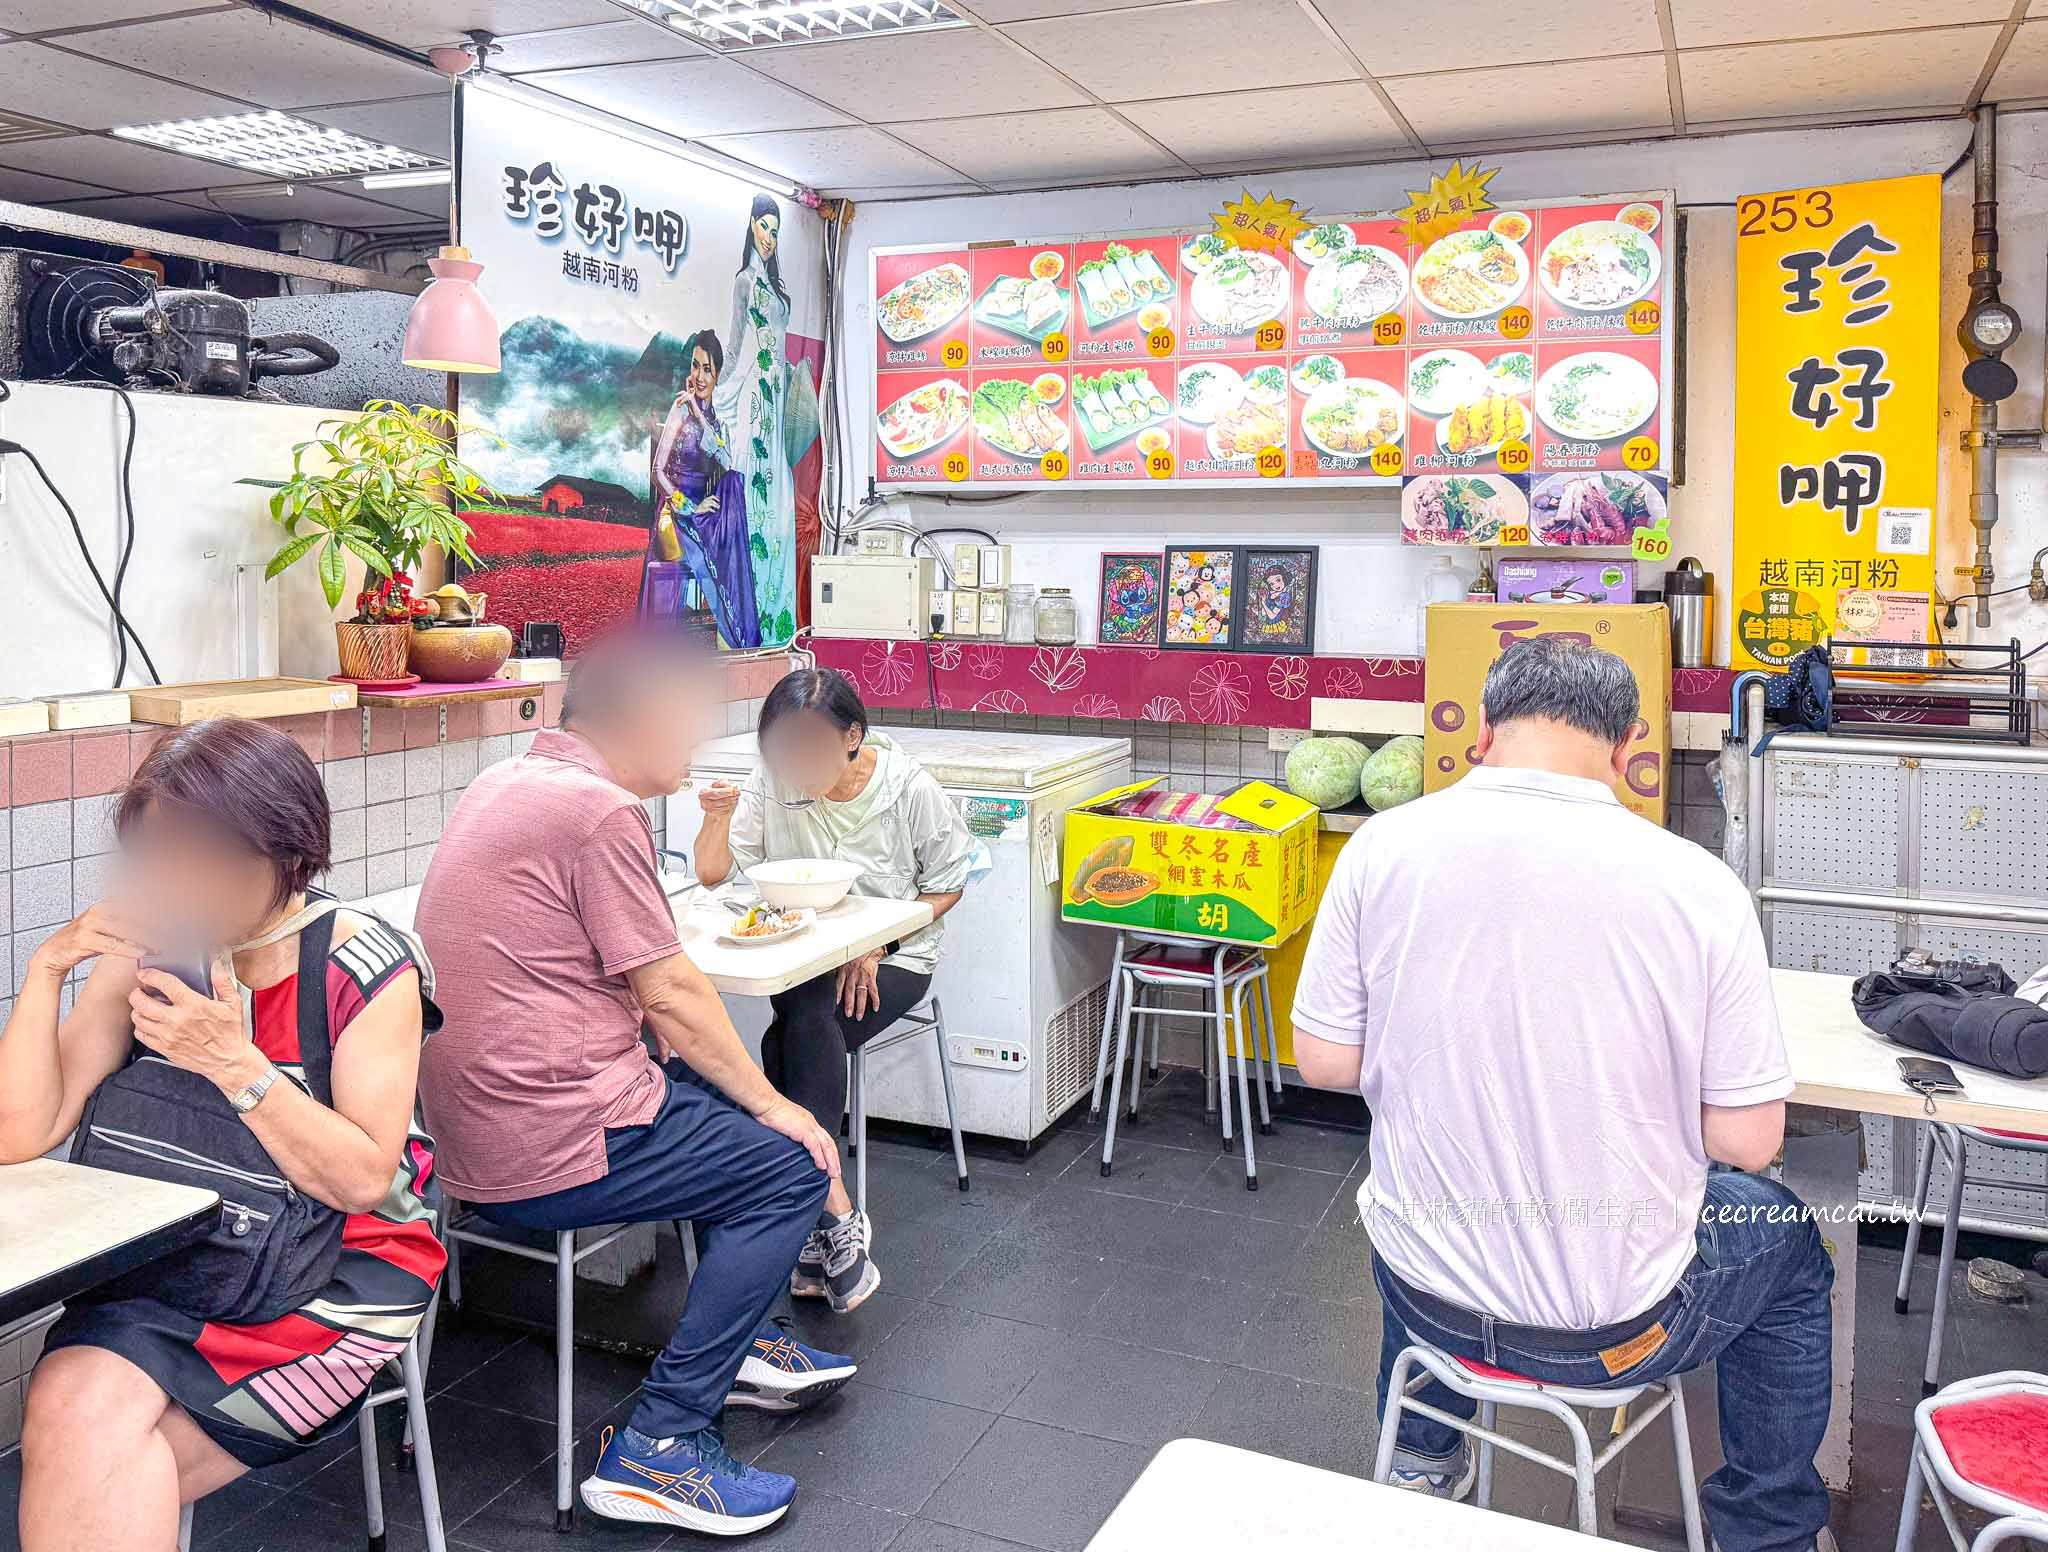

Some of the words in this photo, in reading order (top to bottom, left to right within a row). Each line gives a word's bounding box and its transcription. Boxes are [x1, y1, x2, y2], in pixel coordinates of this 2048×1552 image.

[503, 161, 686, 268] 珍好呷
[1738, 189, 1835, 237] 253
[561, 250, 640, 293] 越南河粉
[1501, 315, 1530, 330] 140
[1629, 309, 1660, 326] 140
[1257, 326, 1284, 343] 150
[1374, 322, 1402, 337] 150
[1047, 340, 1064, 354] 90
[1152, 335, 1169, 349] 90
[946, 347, 963, 361] 90
[1779, 223, 1898, 533] 珍好呷
[1258, 455, 1282, 469] 120
[1374, 452, 1401, 467] 140
[1500, 449, 1528, 465] 150
[1629, 446, 1651, 462] 70
[947, 460, 964, 473] 90
[1046, 460, 1063, 473] 90
[1153, 457, 1170, 471] 90
[1500, 527, 1528, 543] 120
[1635, 535, 1668, 555] 160
[1759, 558, 1900, 588] 越南河粉
[1769, 591, 1790, 603] 本店
[1769, 604, 1789, 615] 使用
[1744, 616, 1813, 640] 台灣豬
[1751, 647, 1782, 665] TAIWAN
[1150, 830, 1263, 867] 雙冬名產
[1167, 863, 1253, 891] 網室木瓜
[1197, 901, 1229, 932] 胡
